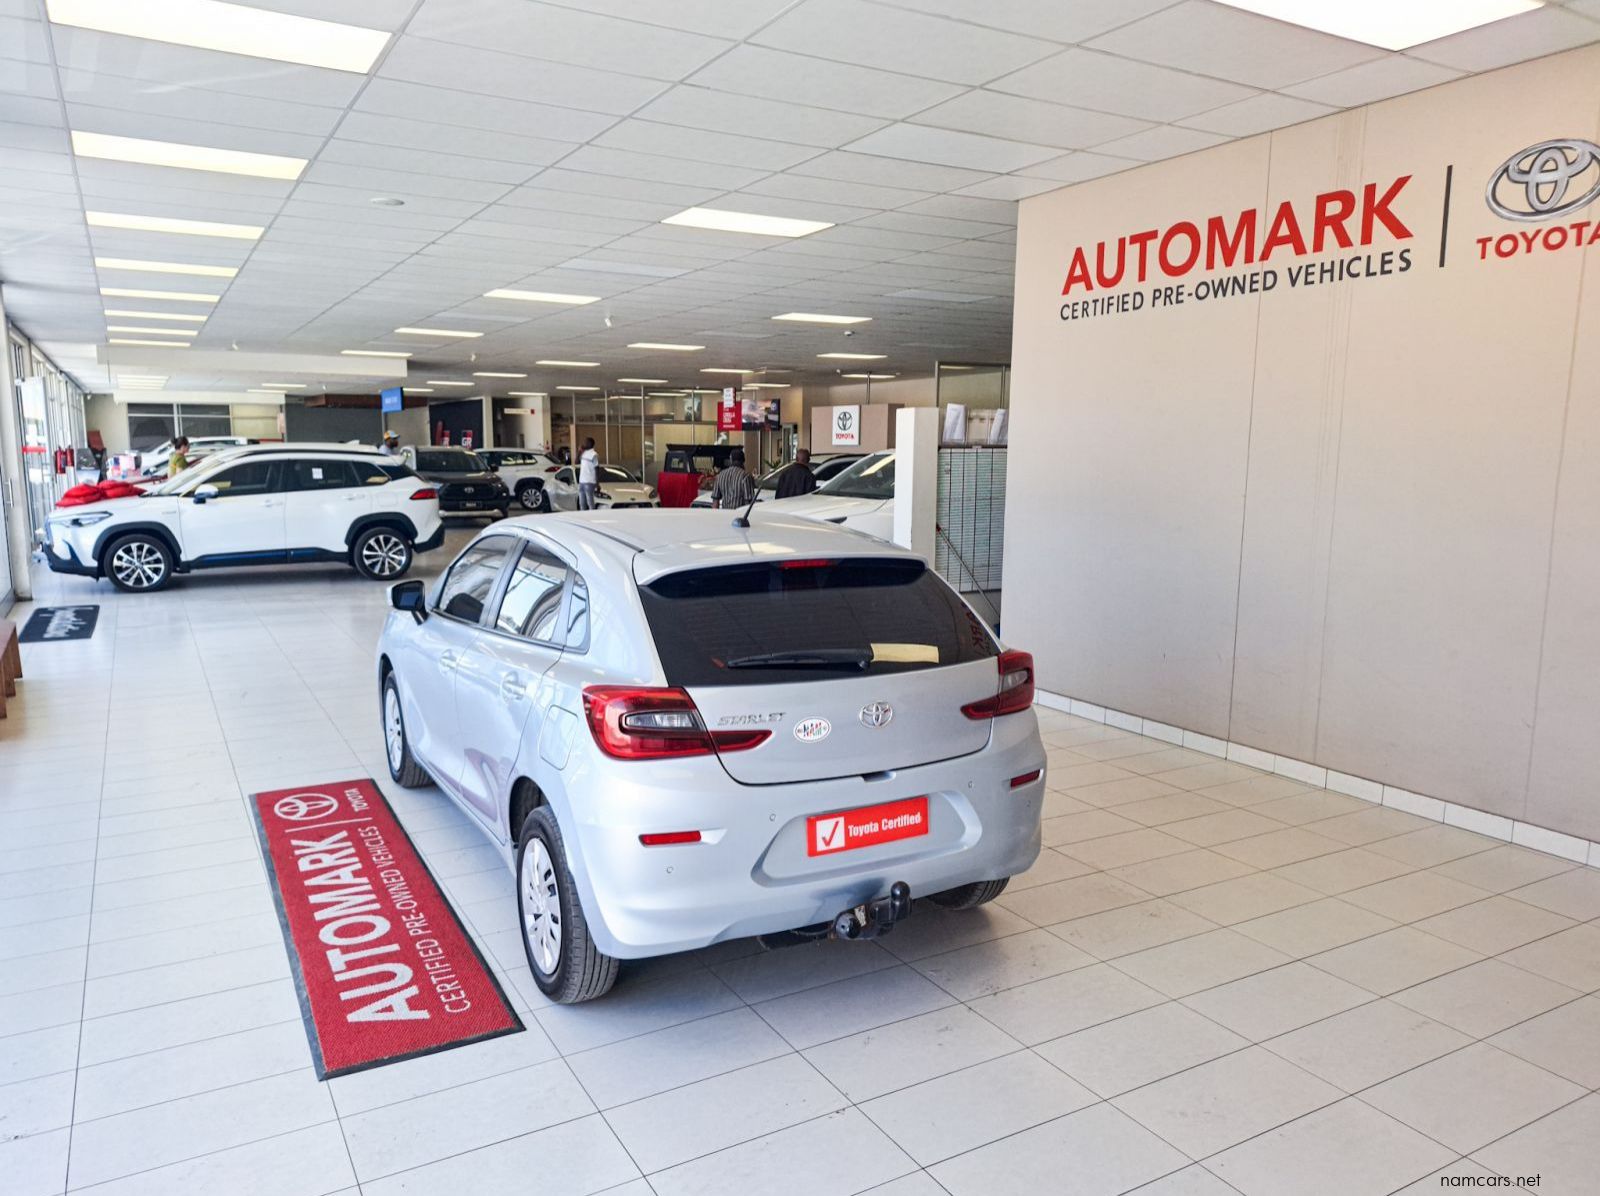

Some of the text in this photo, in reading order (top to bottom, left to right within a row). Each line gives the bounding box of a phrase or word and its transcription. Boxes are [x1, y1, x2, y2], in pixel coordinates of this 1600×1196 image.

[1062, 174, 1413, 295] AUTOMARK
[1060, 248, 1412, 321] CERTIFIED PRE-OWNED VEHICLES
[717, 712, 787, 726] STARLET
[848, 812, 922, 837] Toyota Certified
[290, 830, 430, 1023] AUTOMARK
[357, 826, 471, 1013] CERTIFIED PRE-OWNED VEHICLES
